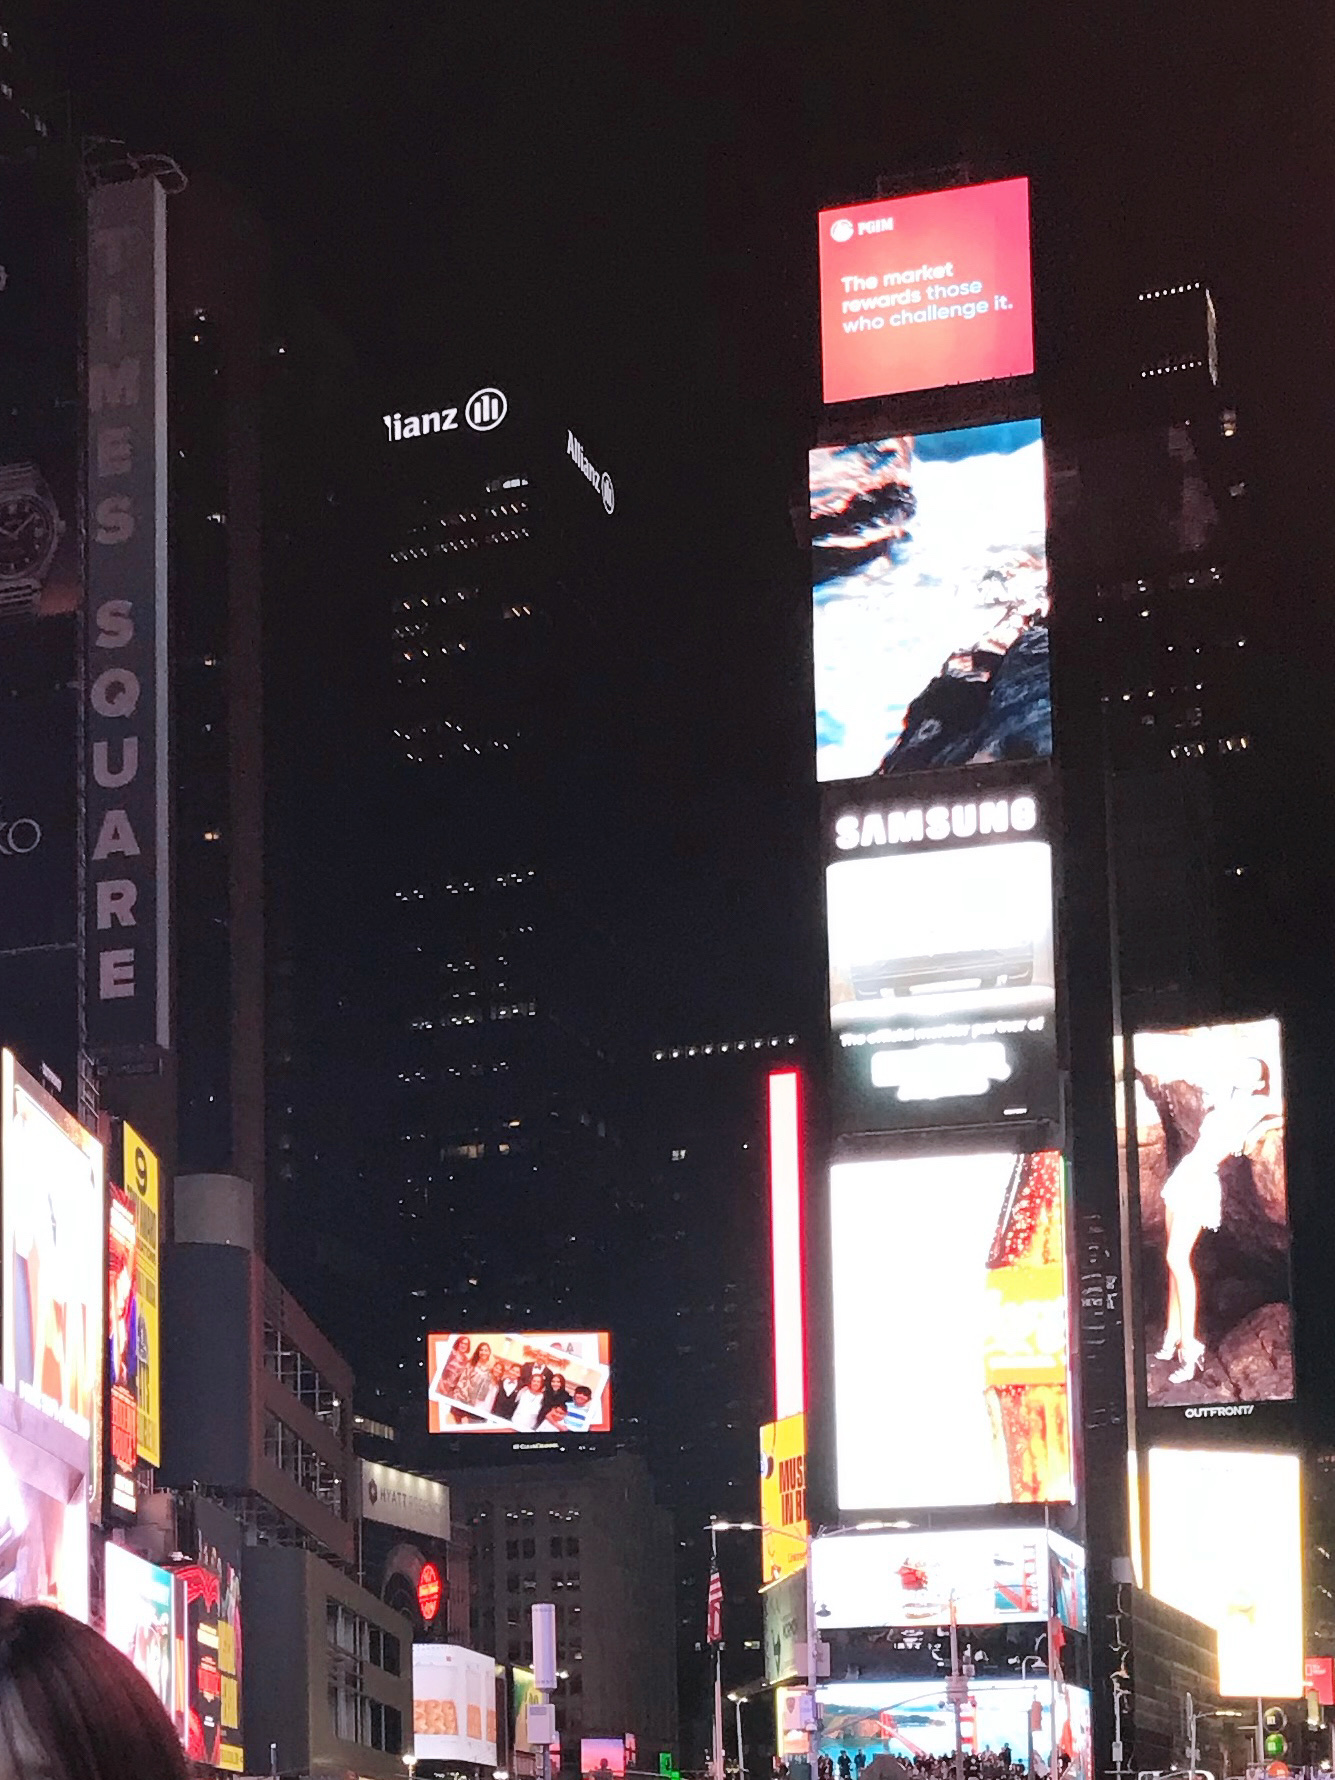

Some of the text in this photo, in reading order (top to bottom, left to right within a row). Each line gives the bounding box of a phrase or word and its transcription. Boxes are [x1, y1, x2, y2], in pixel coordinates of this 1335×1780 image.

[857, 217, 894, 236] PGIM
[841, 262, 954, 293] The market
[842, 280, 982, 314] rewards those
[842, 295, 1013, 333] who challenge it.
[566, 429, 601, 494] Allianz
[88, 226, 142, 1001] TIMES SQUARE
[835, 797, 1037, 850] SAMSUNG
[380, 1491, 407, 1509] HYATT
[781, 1494, 794, 1527] IN
